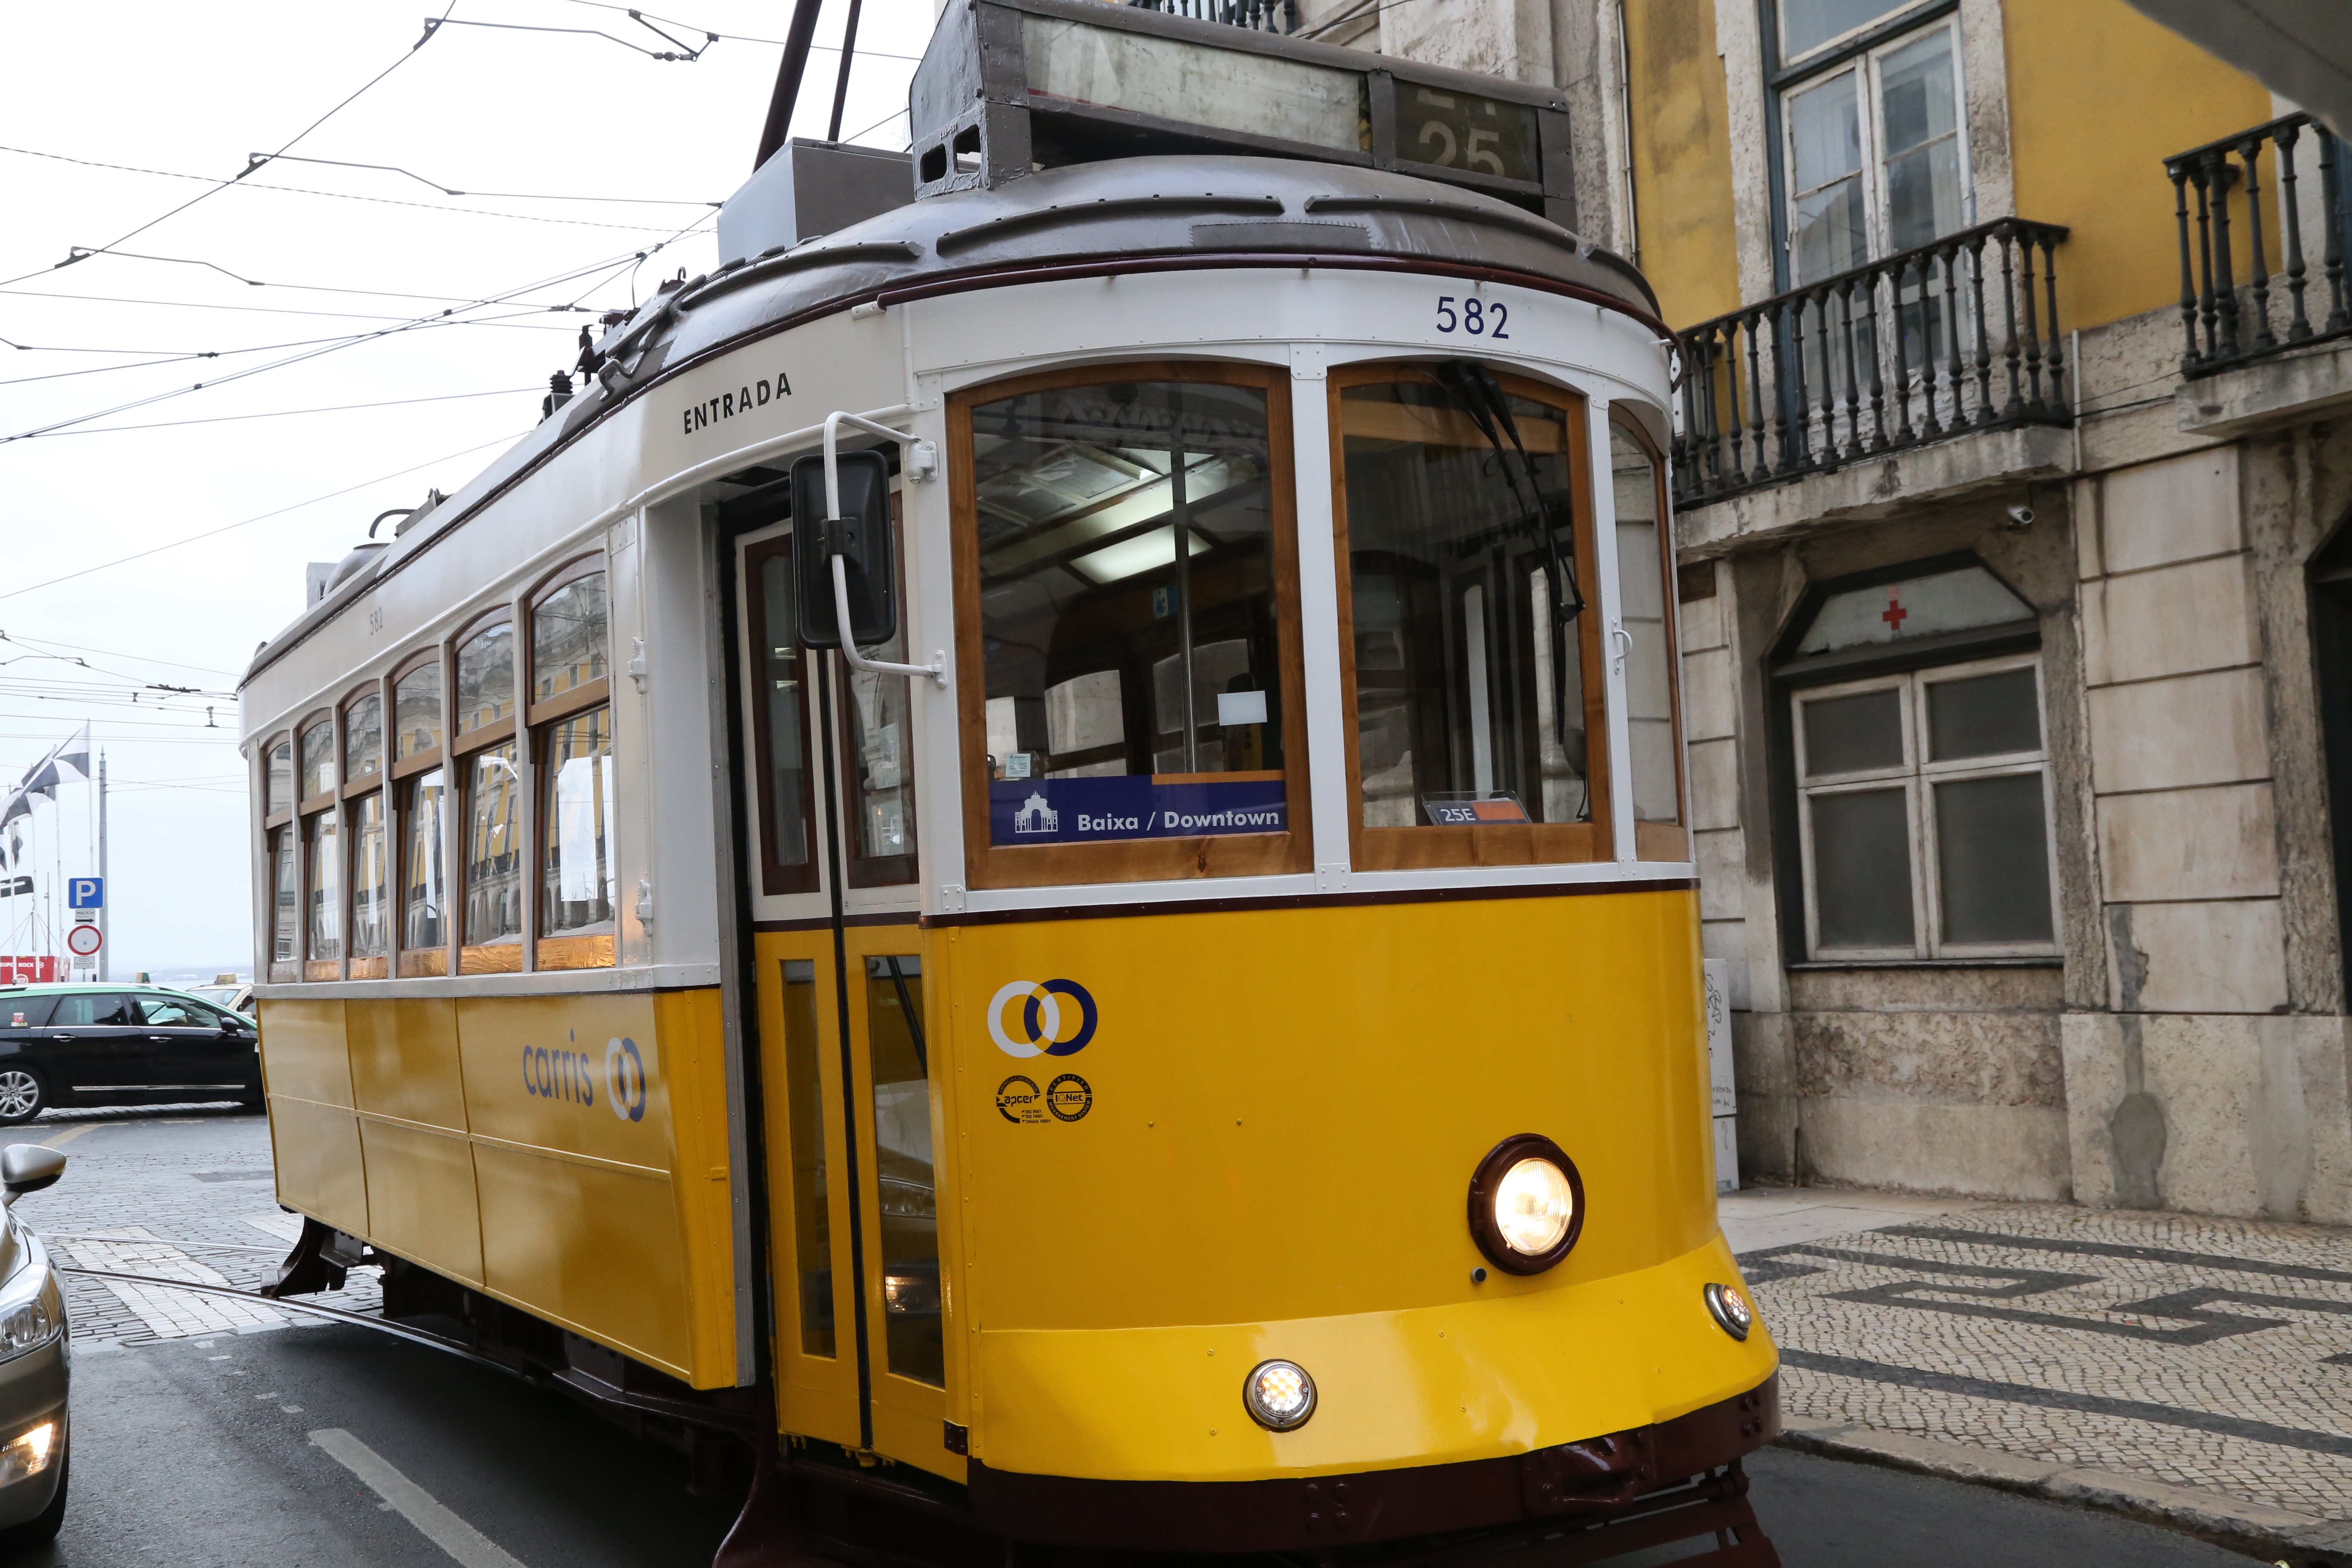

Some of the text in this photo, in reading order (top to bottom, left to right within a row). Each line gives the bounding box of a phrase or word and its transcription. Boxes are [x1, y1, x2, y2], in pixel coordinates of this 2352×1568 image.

[1419, 120, 1505, 177] 25
[1436, 296, 1509, 339] 582
[683, 372, 792, 435] ENTRADA
[370, 606, 383, 636] 582
[1078, 811, 1279, 831] Baixa / Downtown
[1440, 808, 1476, 822] 25E
[76, 880, 96, 906] P
[523, 1028, 594, 1107] carris
[999, 1076, 1038, 1093] EMPRESA CERTIFICADA
[1050, 1075, 1089, 1091] CERTIFIED
[1004, 1096, 1033, 1107] apcer
[1055, 1093, 1083, 1103] IQNet
[1048, 1100, 1091, 1121] MANAGEMENT SYSTEM
